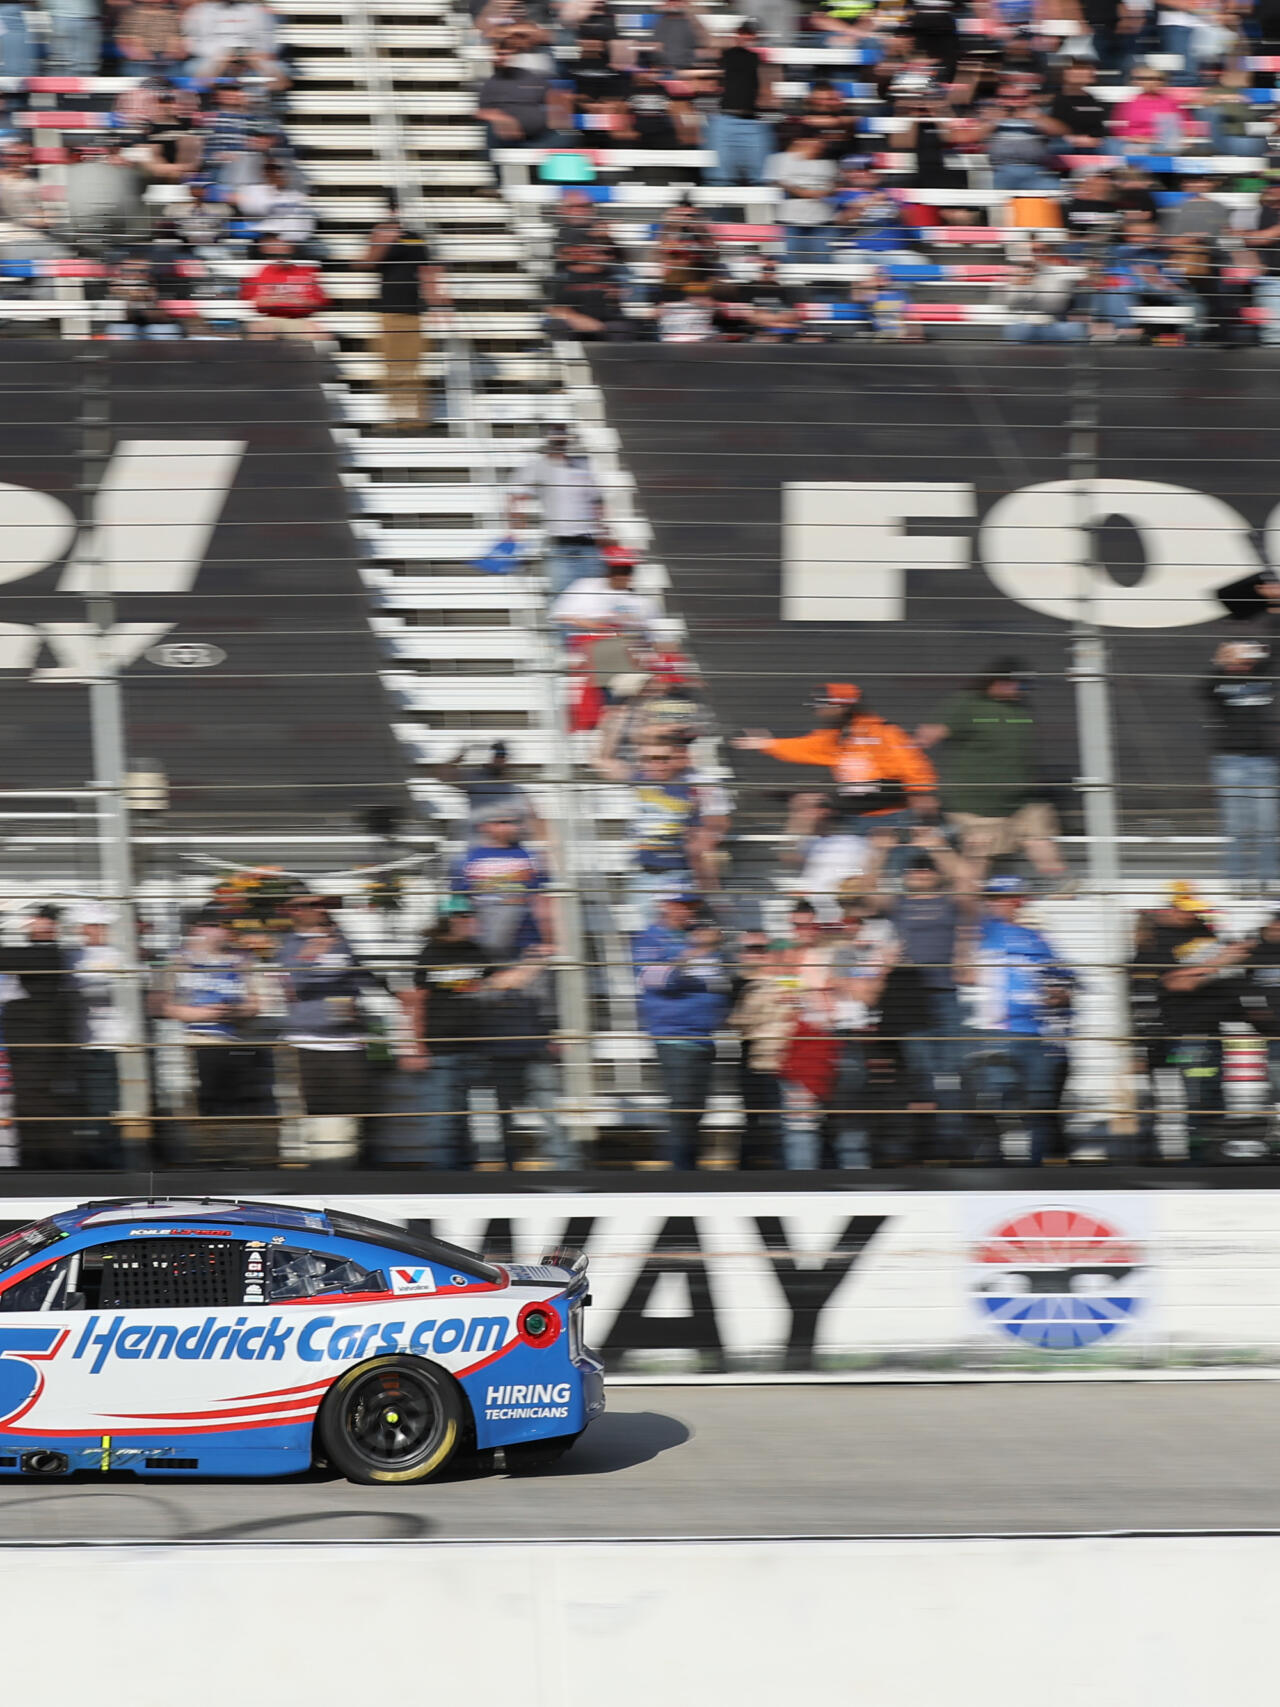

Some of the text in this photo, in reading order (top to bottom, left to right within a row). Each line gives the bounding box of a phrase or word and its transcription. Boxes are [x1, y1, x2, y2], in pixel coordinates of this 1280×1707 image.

[781, 479, 1280, 627] FO
[486, 1383, 572, 1406] HIRING
[485, 1407, 569, 1420] TECHNICIANS
